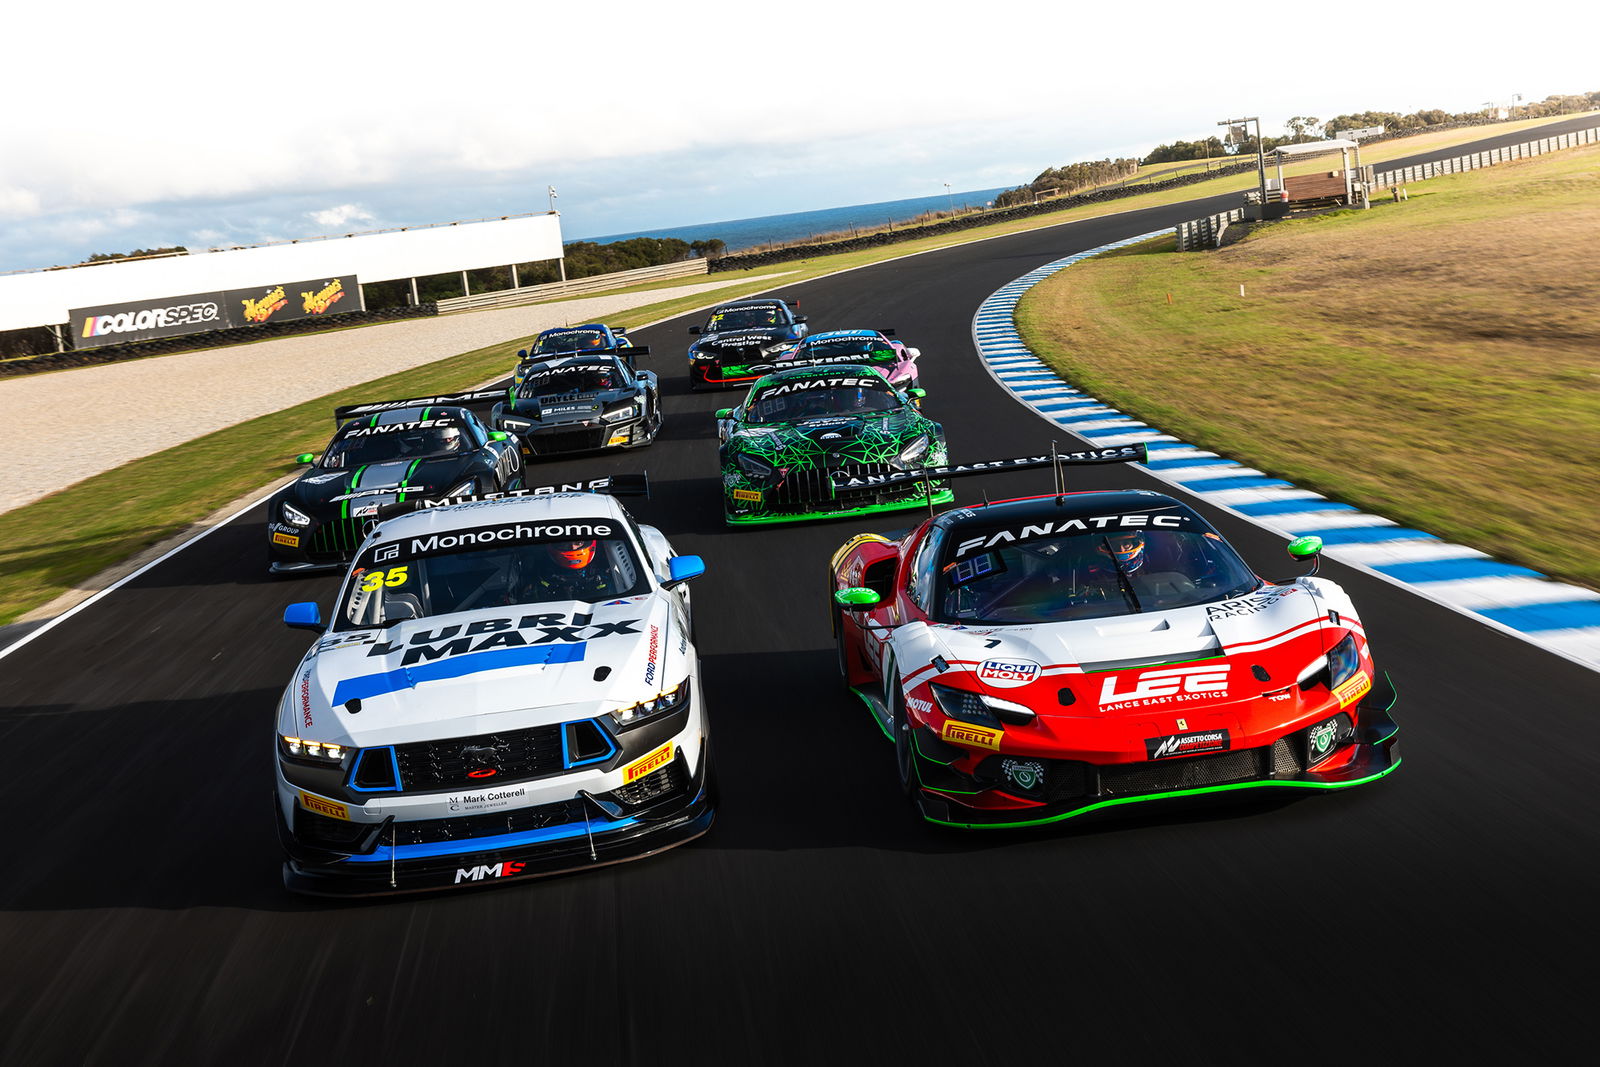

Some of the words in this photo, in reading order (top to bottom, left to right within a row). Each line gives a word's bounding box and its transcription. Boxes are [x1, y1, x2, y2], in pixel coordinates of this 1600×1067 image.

[97, 302, 218, 335] COLORSPEC
[724, 305, 777, 314] Monochrome
[549, 329, 601, 338] Monochrome
[711, 335, 746, 346] Central
[721, 340, 761, 348] Prestige
[810, 336, 884, 346] Monochrome
[528, 365, 613, 380] FANATEC
[760, 378, 876, 400] FANATEC
[343, 418, 452, 440] FANATEC
[424, 478, 611, 508] MUSTANG
[411, 523, 612, 554] Monochrome
[956, 513, 1184, 557] FANATEC
[362, 566, 409, 593] 35
[367, 612, 594, 657] LUBRI
[400, 619, 643, 667] MAXX
[982, 669, 1034, 682] MOLY
[986, 661, 1035, 674] LIQUI
[1098, 664, 1232, 706] LEE
[1339, 675, 1370, 703] PIRELLI
[906, 697, 934, 714] MOTUL
[1099, 700, 1140, 713] LANCE
[1143, 695, 1174, 706] EAST
[1177, 691, 1229, 702] EXOTICS
[1268, 693, 1292, 702] TOW
[945, 724, 997, 746] PIRELLI
[1179, 735, 1204, 745] ASSETTO
[1204, 733, 1223, 742] CORSA
[626, 745, 672, 783] PIRELLI
[301, 793, 350, 820] PIRELLI
[463, 794, 486, 804] Mark
[487, 788, 526, 801] Cotterell
